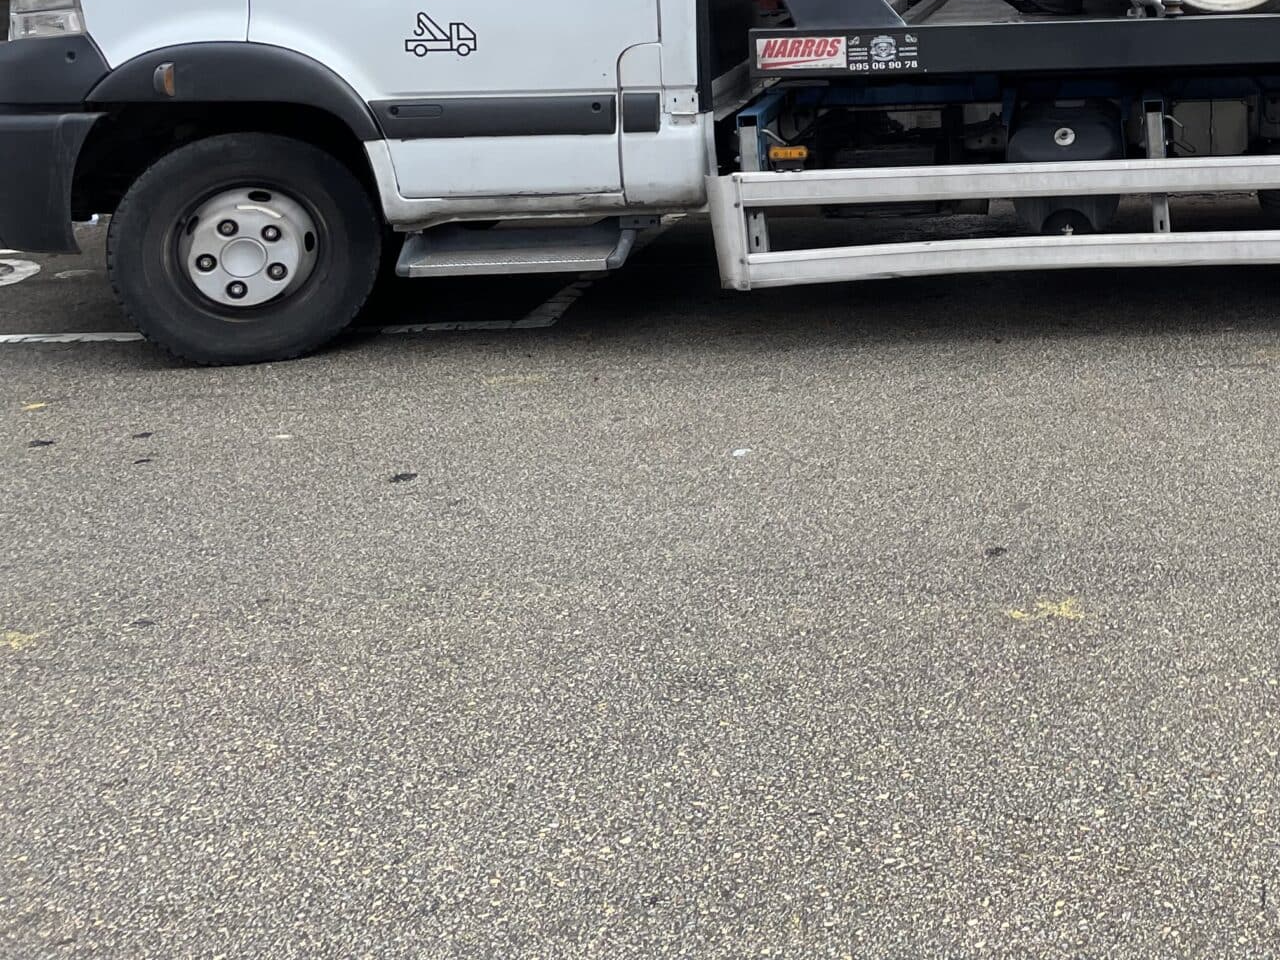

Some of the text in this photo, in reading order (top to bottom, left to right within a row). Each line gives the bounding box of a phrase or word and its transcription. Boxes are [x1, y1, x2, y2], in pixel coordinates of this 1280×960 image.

[762, 38, 841, 58] NARROS
[849, 63, 869, 71] 695
[872, 62, 886, 70] 06
[888, 61, 902, 69] 90
[904, 60, 918, 69] 78
